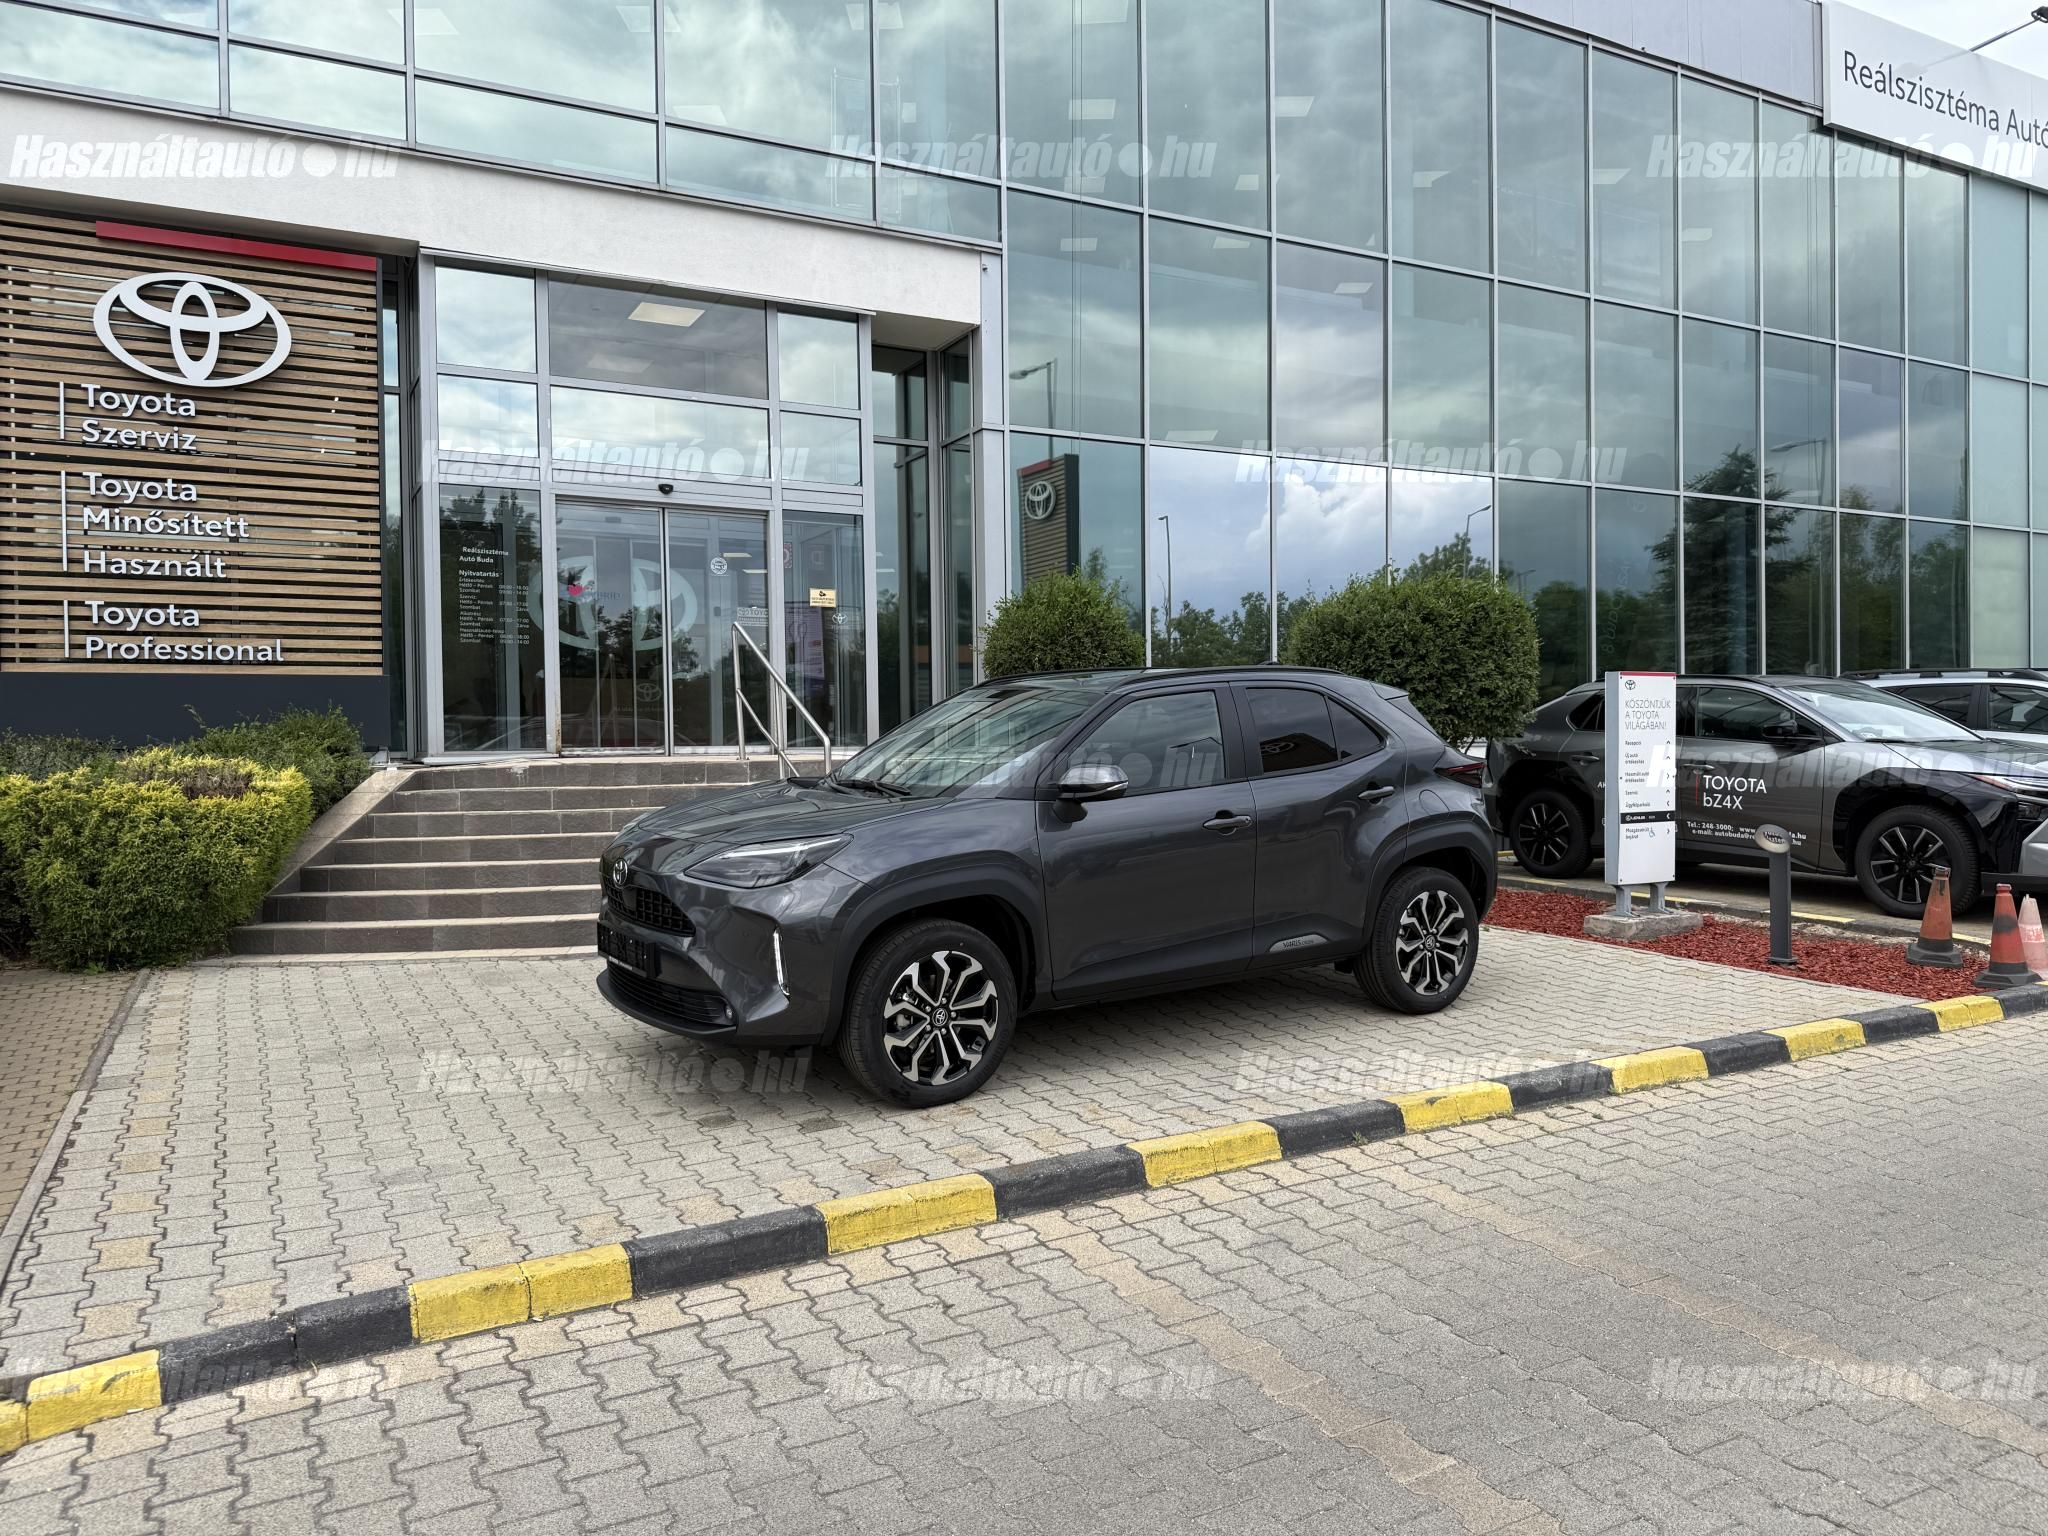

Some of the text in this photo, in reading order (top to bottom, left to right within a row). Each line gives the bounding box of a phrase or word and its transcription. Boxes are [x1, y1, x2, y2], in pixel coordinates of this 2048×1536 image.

[1843, 49, 1999, 132] Reálszisztéma
[80, 383, 197, 418] Toyota
[81, 419, 198, 451] Szerviz
[82, 471, 198, 504] Toyota
[83, 507, 250, 538] Minősített
[84, 550, 227, 579] Használt
[462, 546, 509, 556] Reálszisztéma
[476, 556, 494, 564] Buda
[84, 600, 200, 632] Toyota
[86, 636, 284, 662] Professional
[1632, 710, 1660, 720] TOYOTA
[1702, 775, 1768, 794] TOYOTA
[1703, 792, 1744, 810] bZ4X
